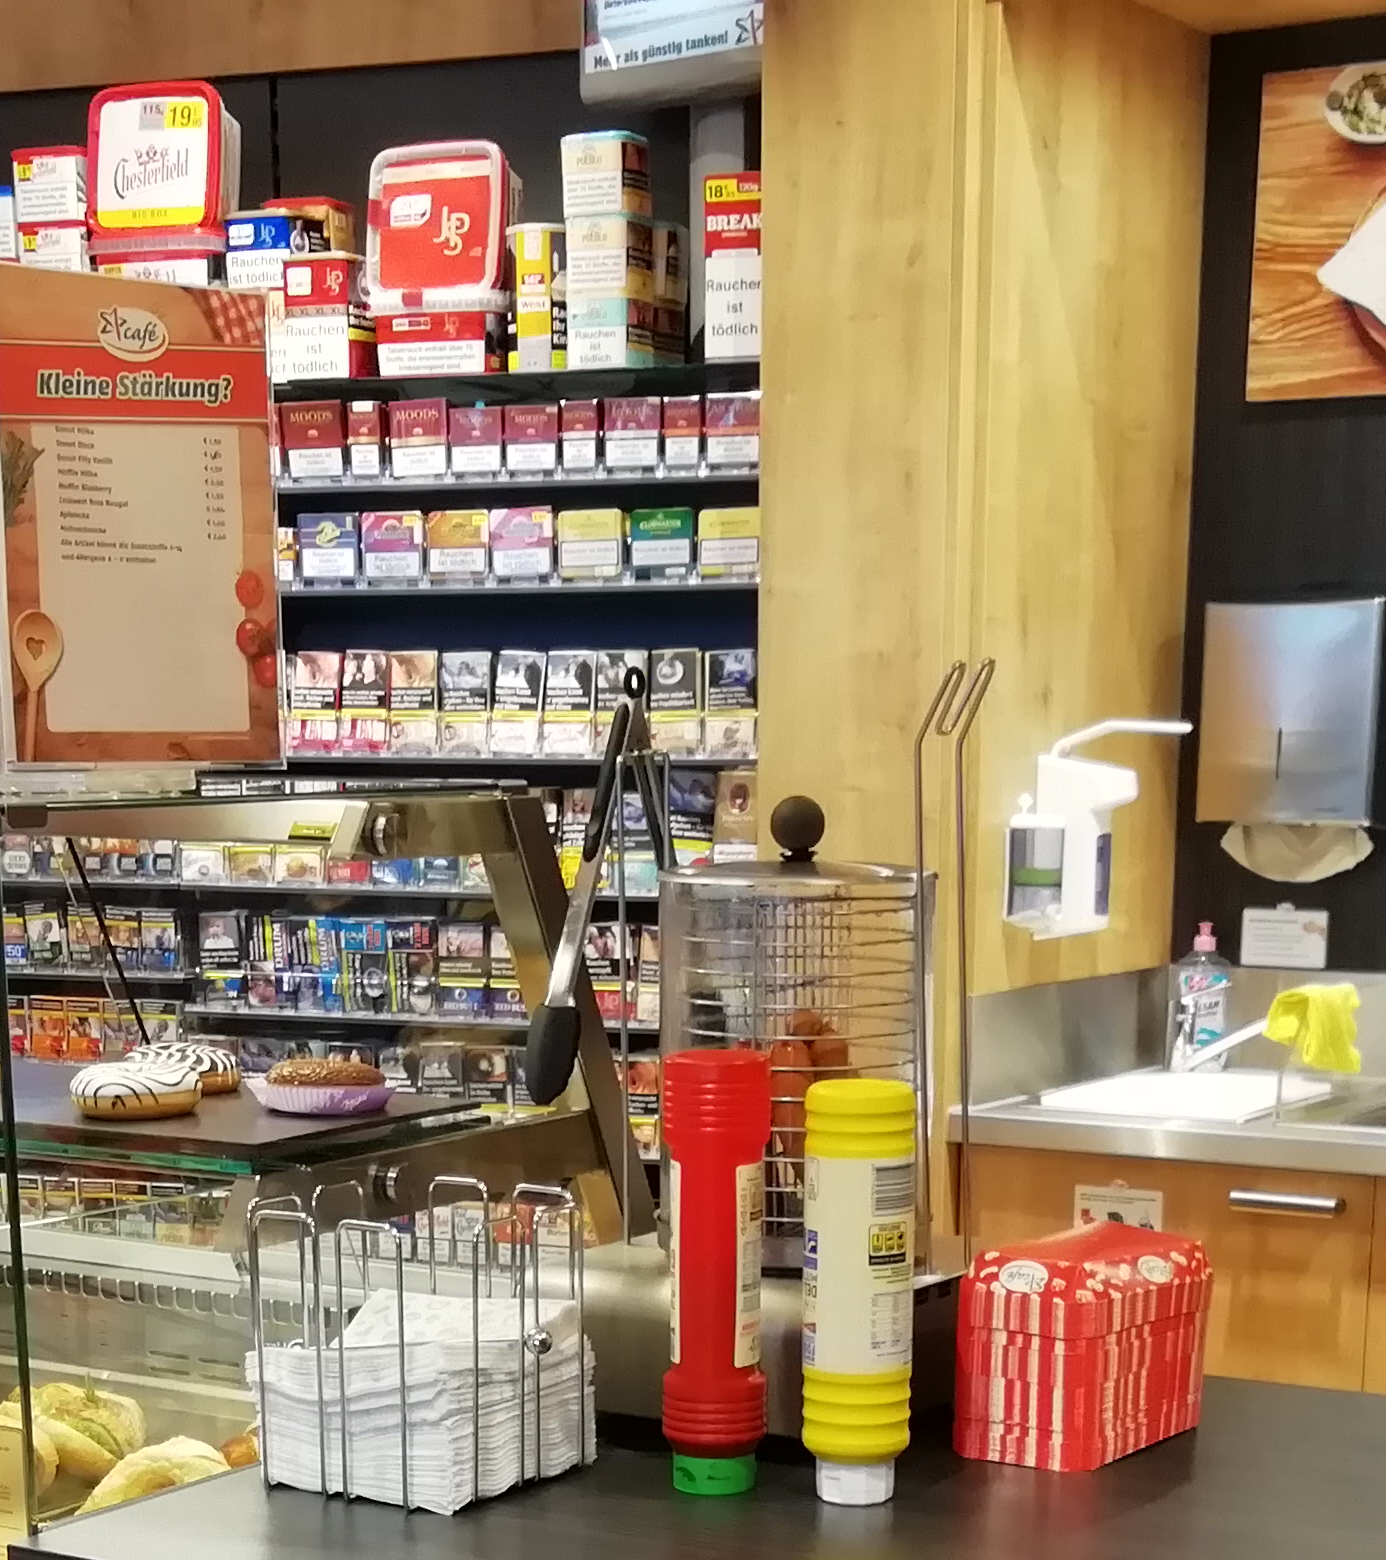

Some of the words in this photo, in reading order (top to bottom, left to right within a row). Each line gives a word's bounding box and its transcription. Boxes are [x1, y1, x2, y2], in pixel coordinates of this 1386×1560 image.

[594, 54, 620, 69] Mer
[625, 50, 638, 63] als
[642, 41, 682, 62] günstig
[114, 148, 188, 199] Chesterfield
[727, 303, 743, 314] ist
[124, 321, 159, 349] café
[286, 325, 344, 337] Rauchen
[575, 330, 616, 340] Rauchen
[712, 323, 758, 337] tödlich
[307, 344, 321, 354] ist
[293, 359, 337, 373] tödlich
[39, 371, 110, 397] Kleine
[117, 373, 232, 405] Stärkung?
[290, 410, 333, 423] MOODS
[396, 409, 439, 422] MOODS
[274, 923, 284, 968] DRUM
